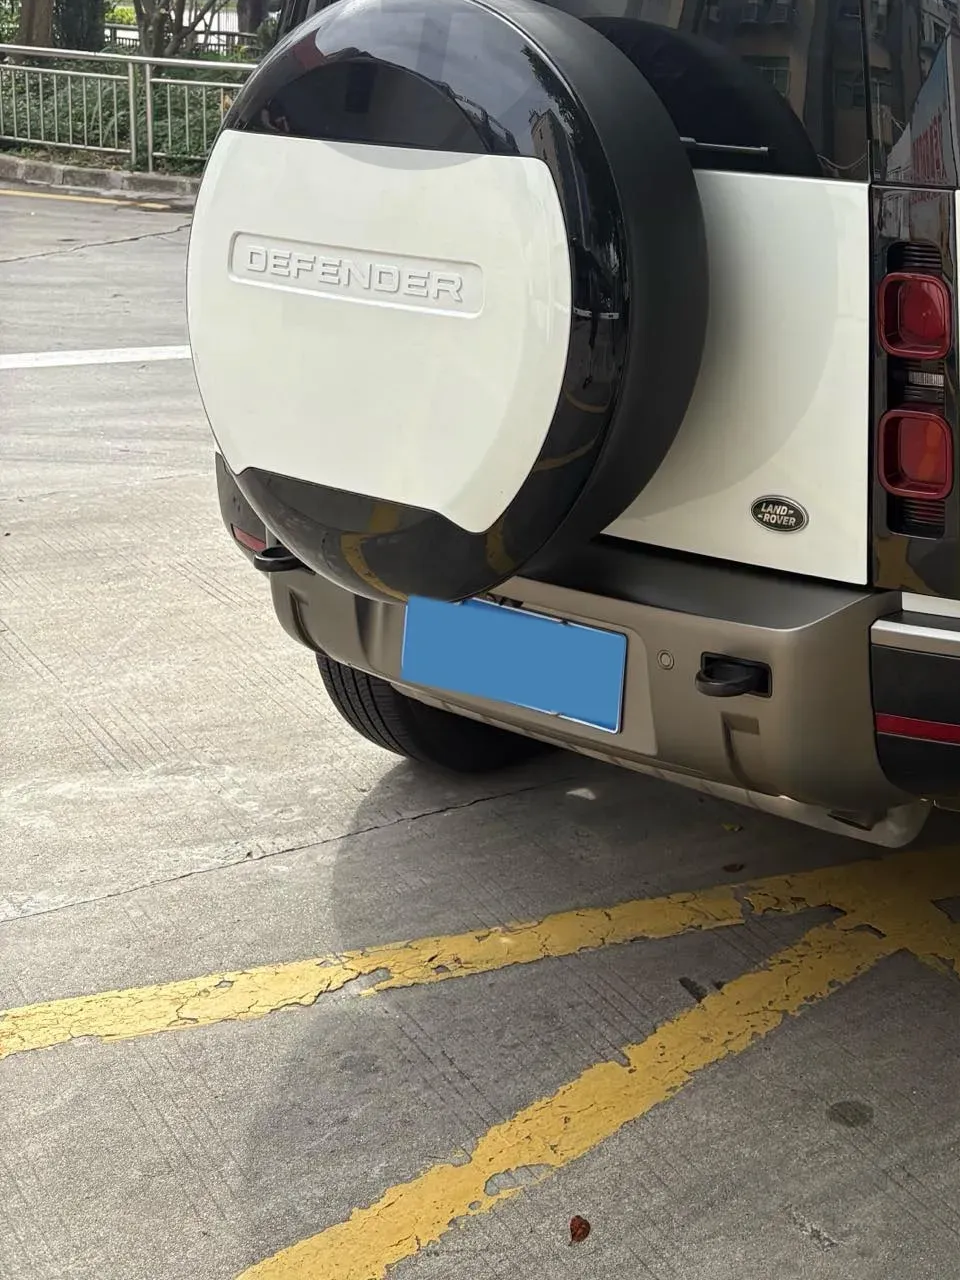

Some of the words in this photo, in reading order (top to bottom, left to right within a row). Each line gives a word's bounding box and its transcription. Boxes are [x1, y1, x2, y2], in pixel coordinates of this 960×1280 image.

[247, 245, 463, 303] DEFENDER
[761, 503, 788, 515] LAND
[763, 513, 796, 526] ROVER
